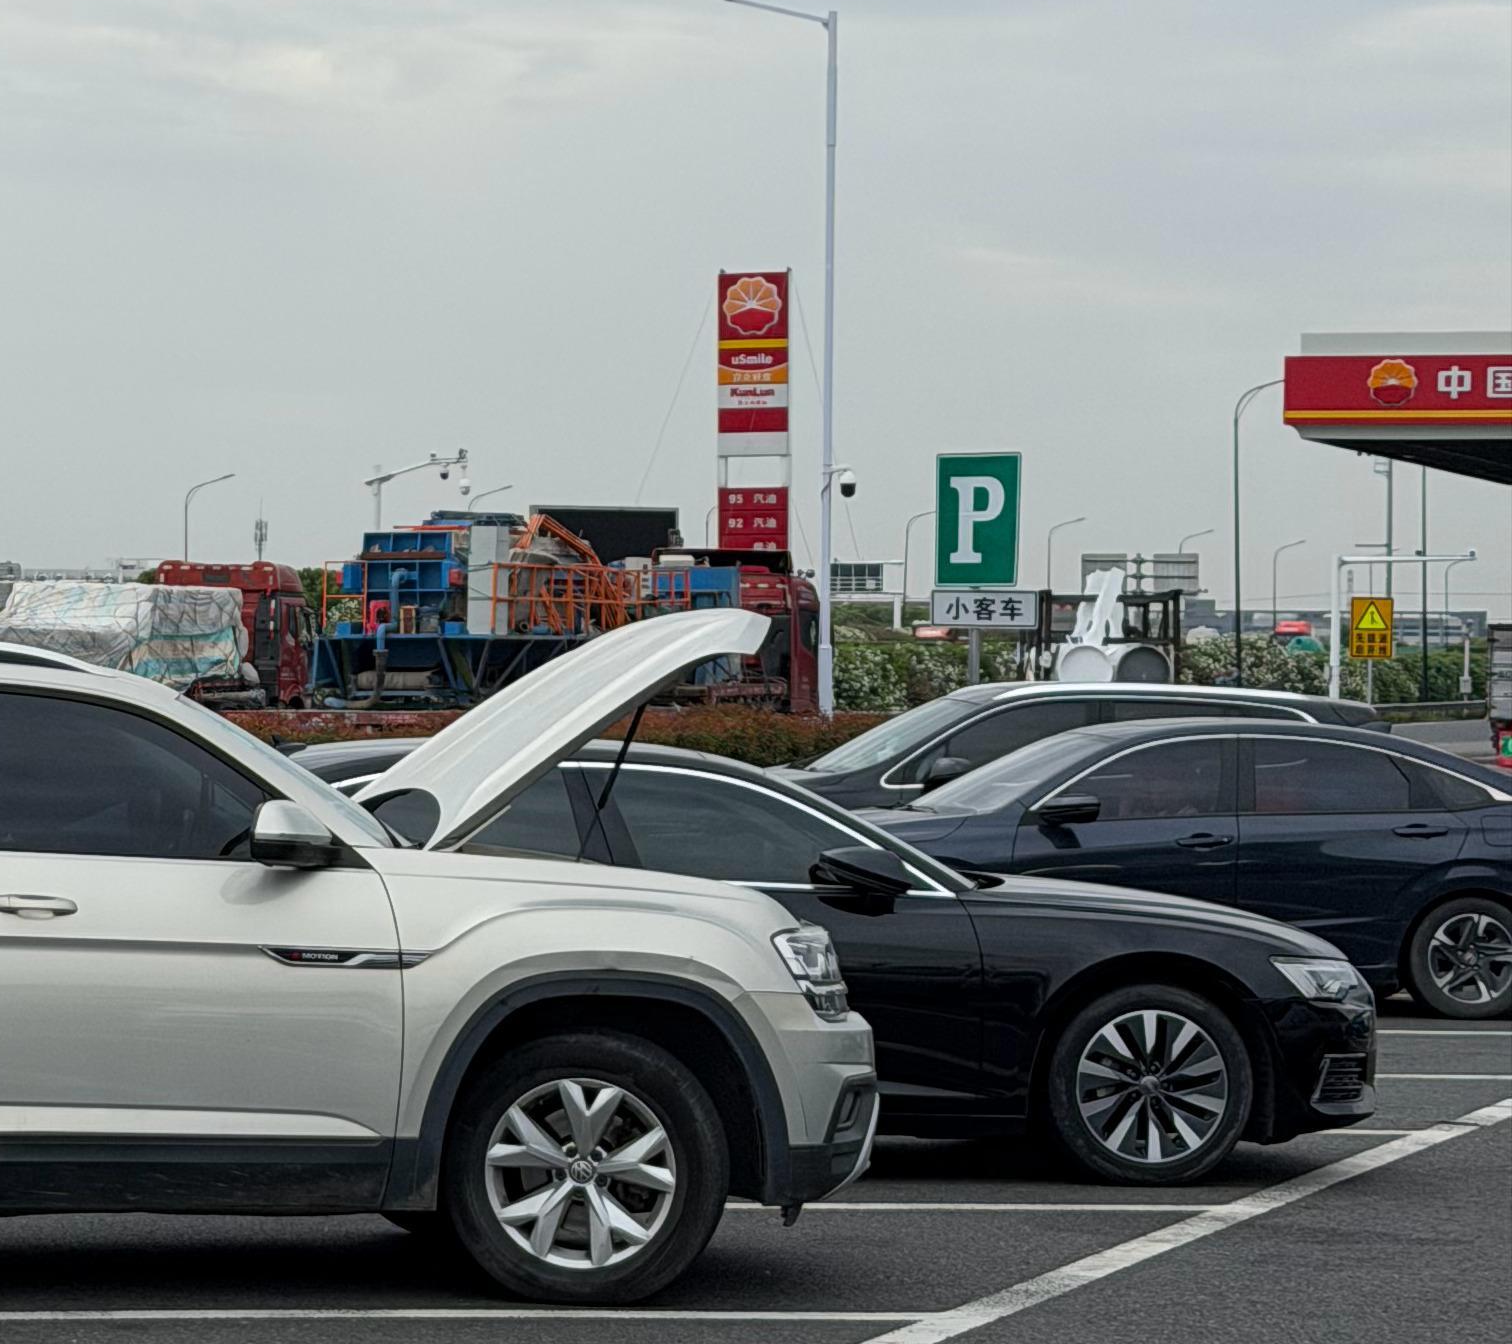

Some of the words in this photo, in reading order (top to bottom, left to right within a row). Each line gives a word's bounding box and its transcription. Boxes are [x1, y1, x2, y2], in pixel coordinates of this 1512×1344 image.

[731, 353, 774, 365] uSmile
[1437, 365, 1512, 399] 中国
[728, 494, 743, 504] 95
[728, 518, 743, 528] 92
[949, 476, 1005, 564] P
[945, 597, 1023, 621] 小客车
